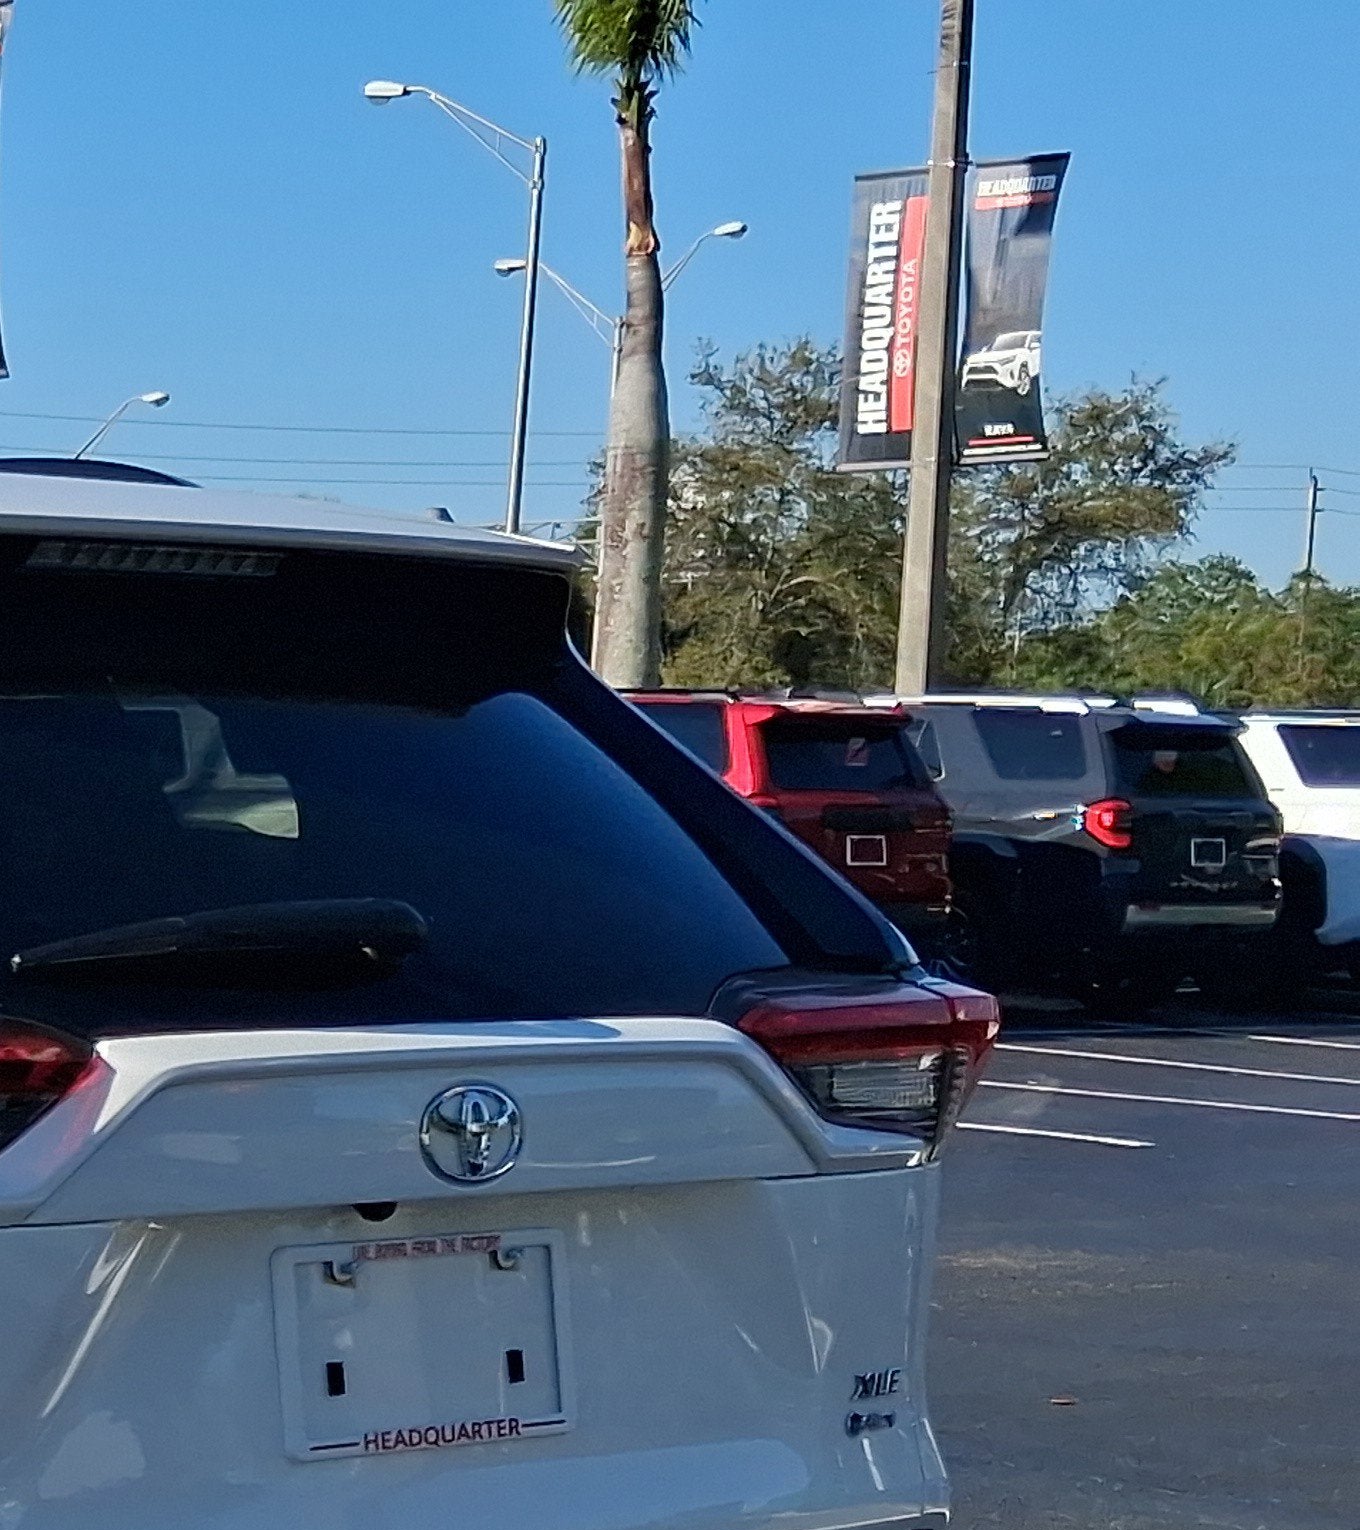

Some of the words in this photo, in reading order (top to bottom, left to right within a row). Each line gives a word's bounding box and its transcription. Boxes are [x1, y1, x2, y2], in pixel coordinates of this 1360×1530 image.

[857, 200, 903, 435] HEADQUARTER
[896, 258, 918, 348] TOYOTA
[363, 1417, 523, 1451] HEADQUARTER
